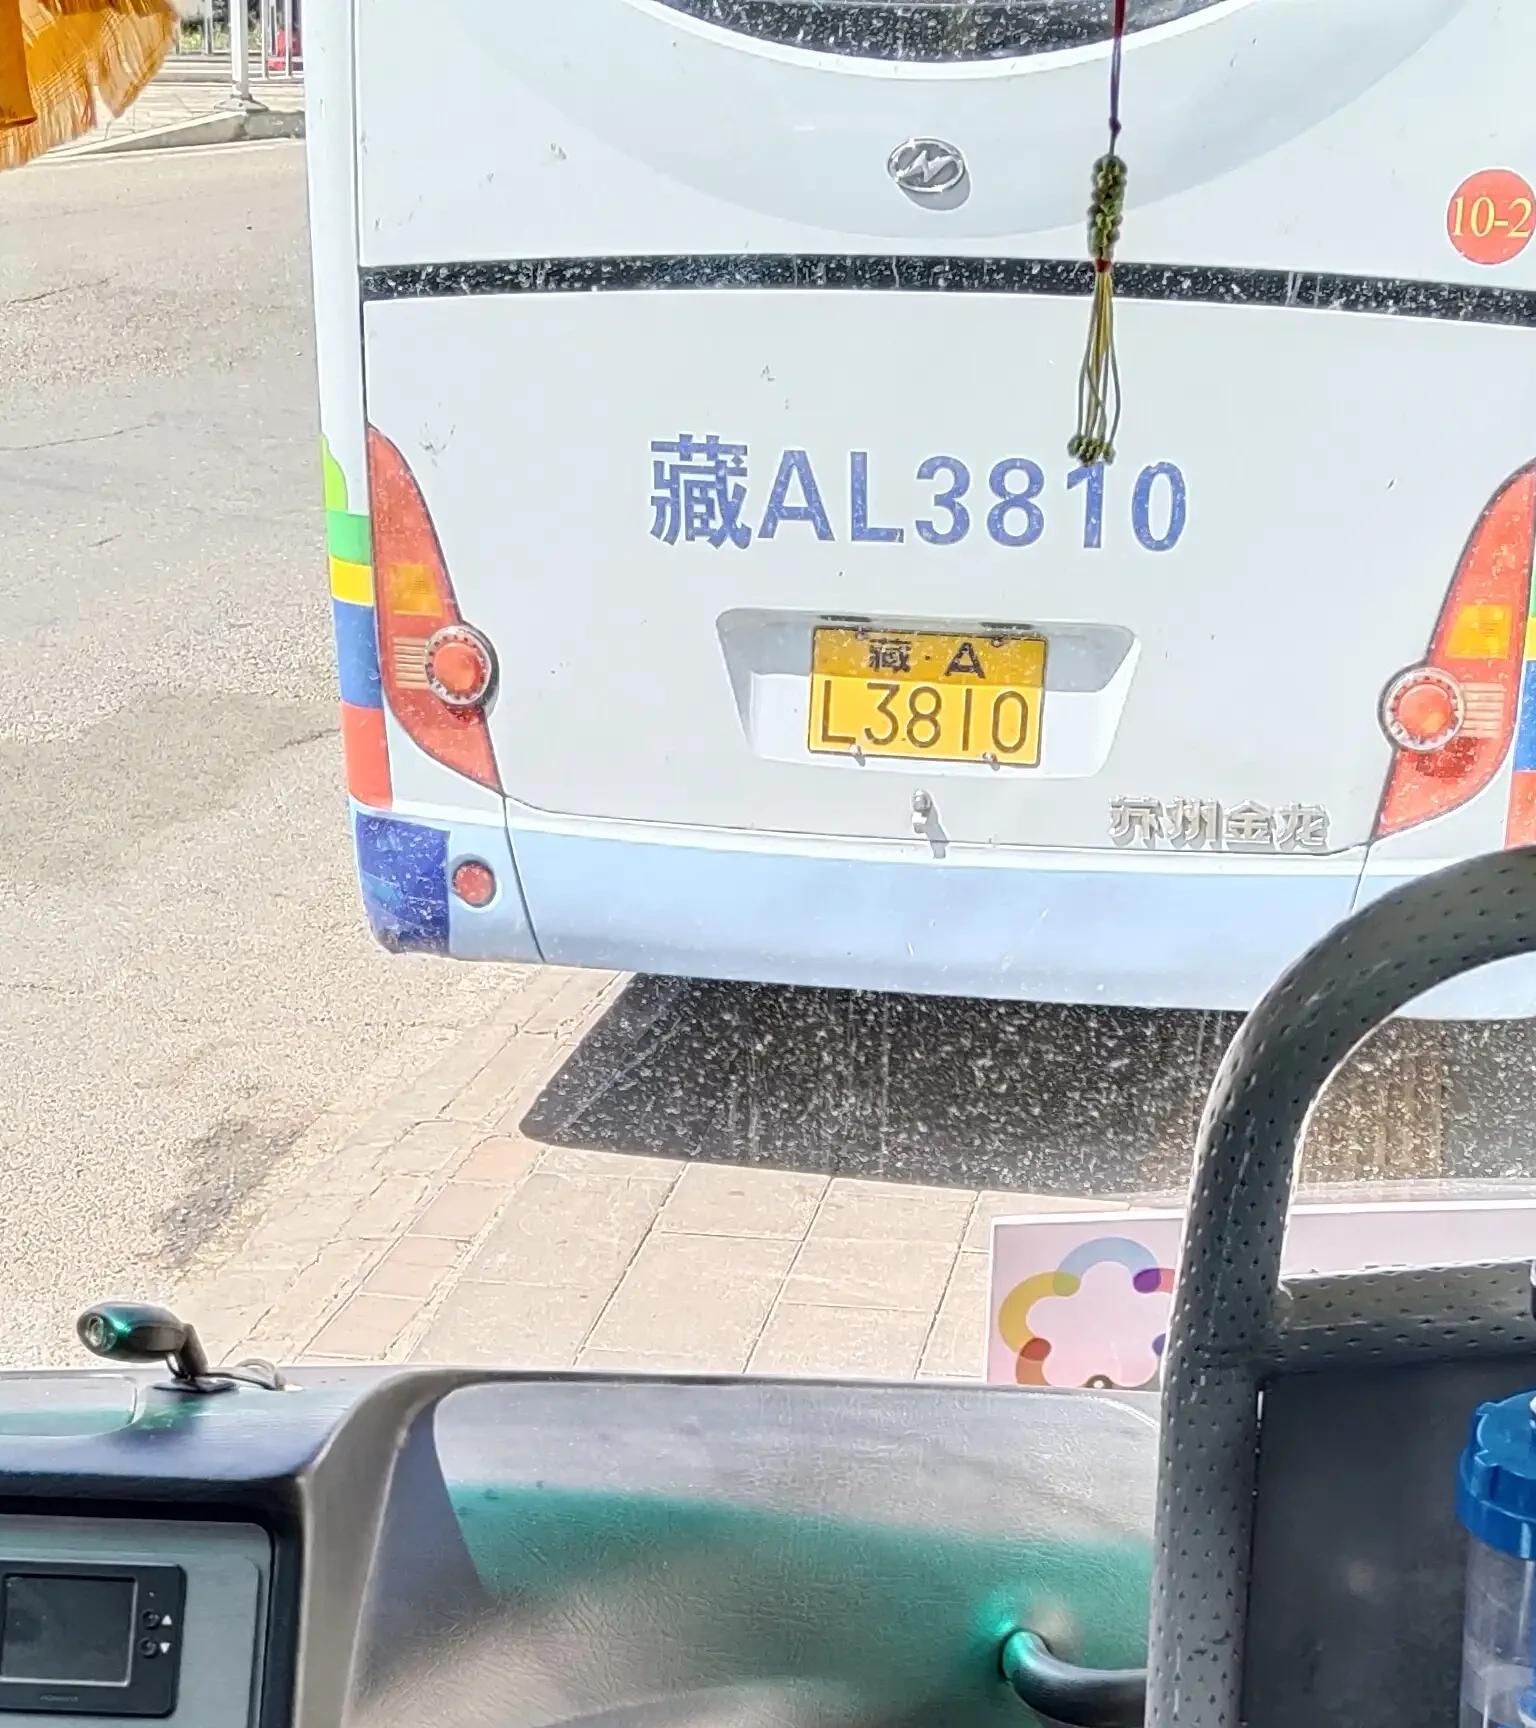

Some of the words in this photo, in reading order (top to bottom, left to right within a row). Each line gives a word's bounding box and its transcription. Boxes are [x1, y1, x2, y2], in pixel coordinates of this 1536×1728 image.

[1452, 196, 1533, 238] 10-2
[649, 433, 1187, 552] 藏AL3810
[820, 680, 1029, 756] L3810
[1108, 797, 1328, 846] 苏州金龙
